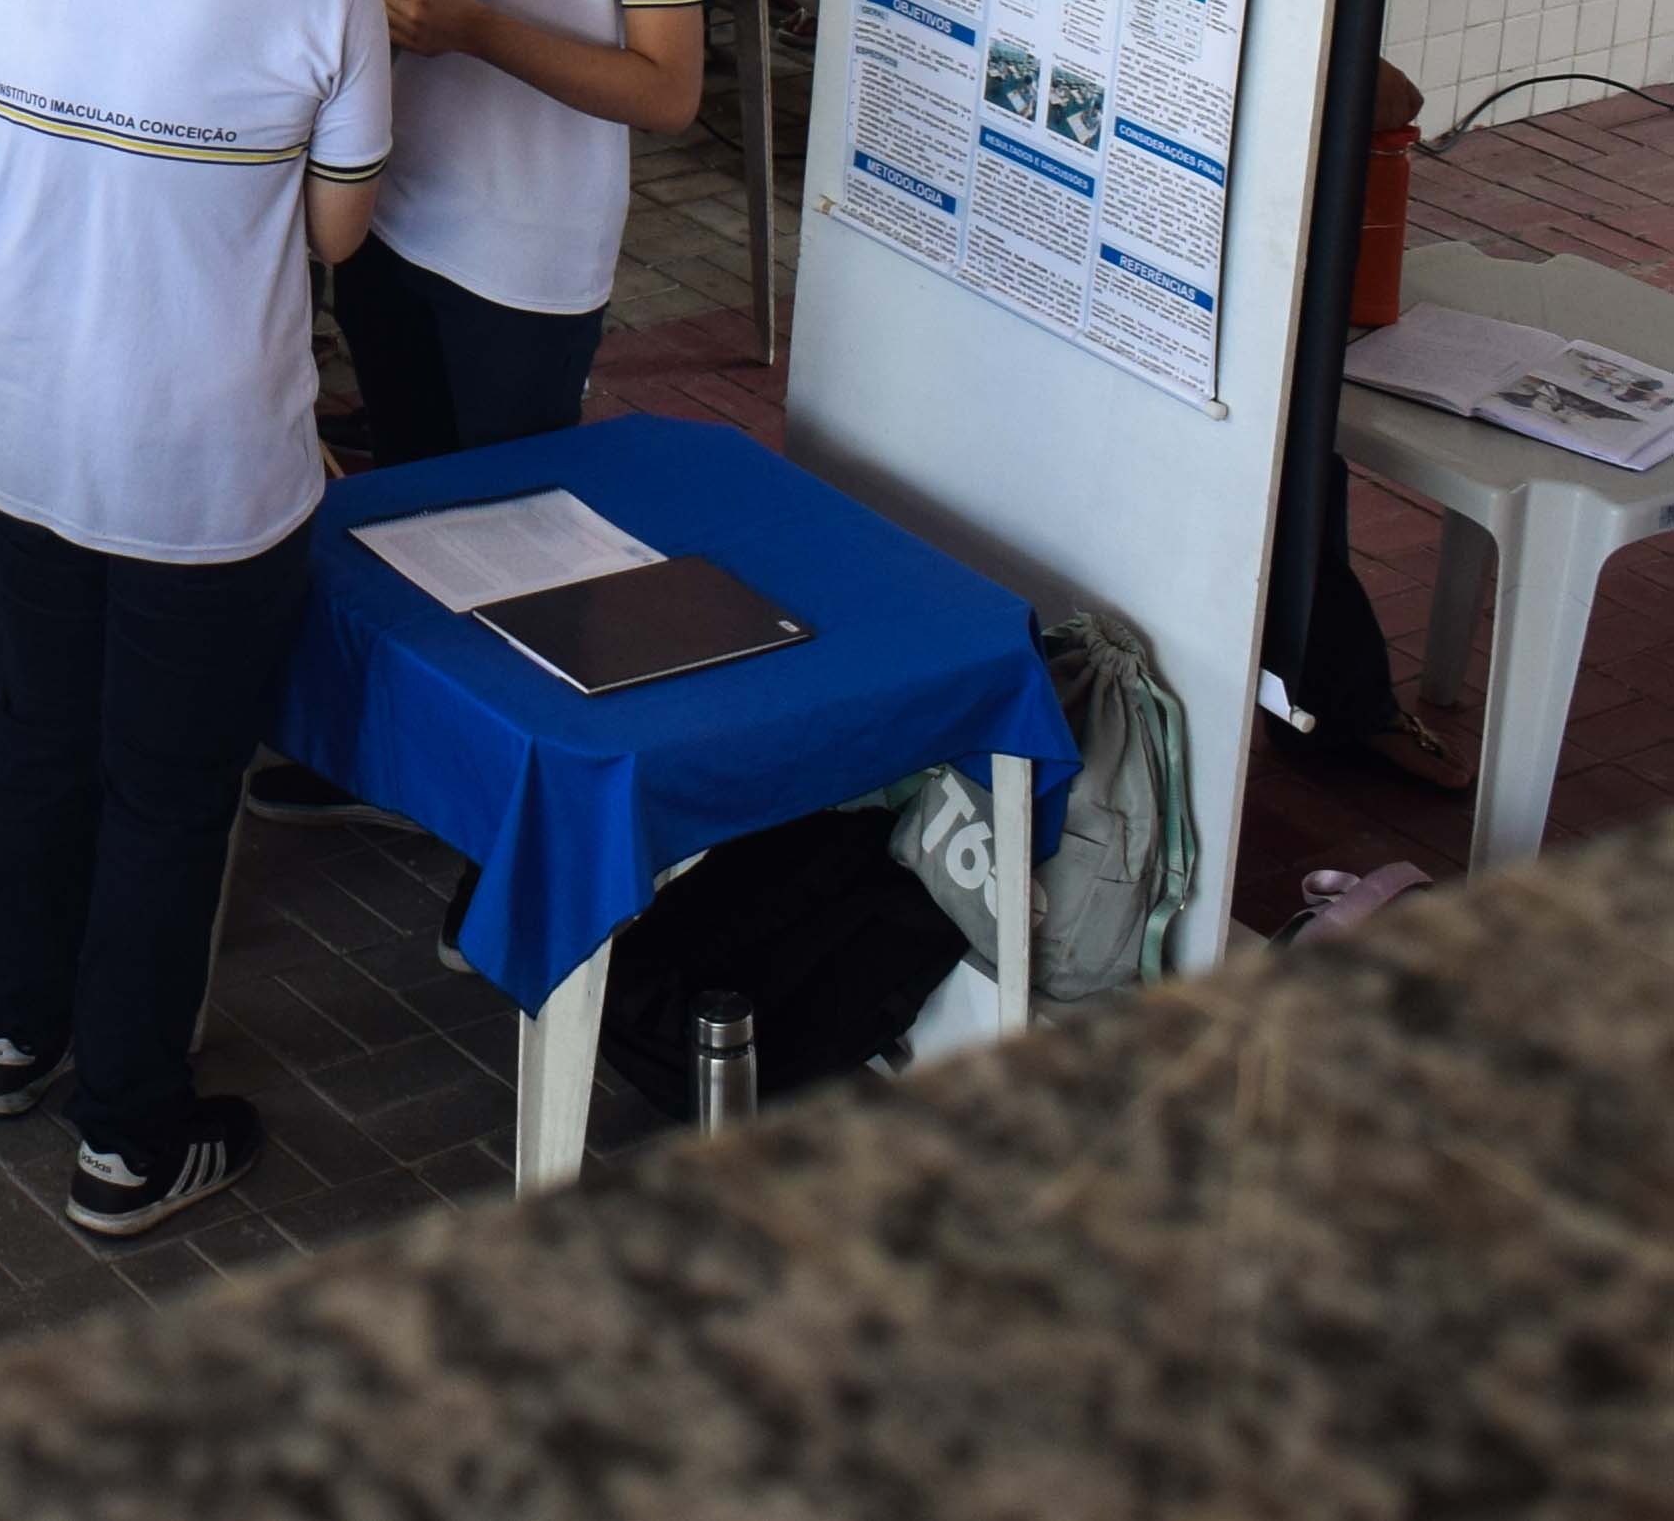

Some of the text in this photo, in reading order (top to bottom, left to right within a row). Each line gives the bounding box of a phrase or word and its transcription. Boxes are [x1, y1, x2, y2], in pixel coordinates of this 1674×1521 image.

[50, 99, 136, 130] IMACULADA
[139, 119, 237, 143] CONCEIÇÃO
[984, 134, 1034, 165] RESULTADOS
[1040, 158, 1089, 190] DISCUSSÕES
[1118, 123, 1197, 167] CONSIDERAÇÕES
[866, 158, 944, 207] METODOLOGIA
[1119, 255, 1197, 301] REFERÊNCIAS
